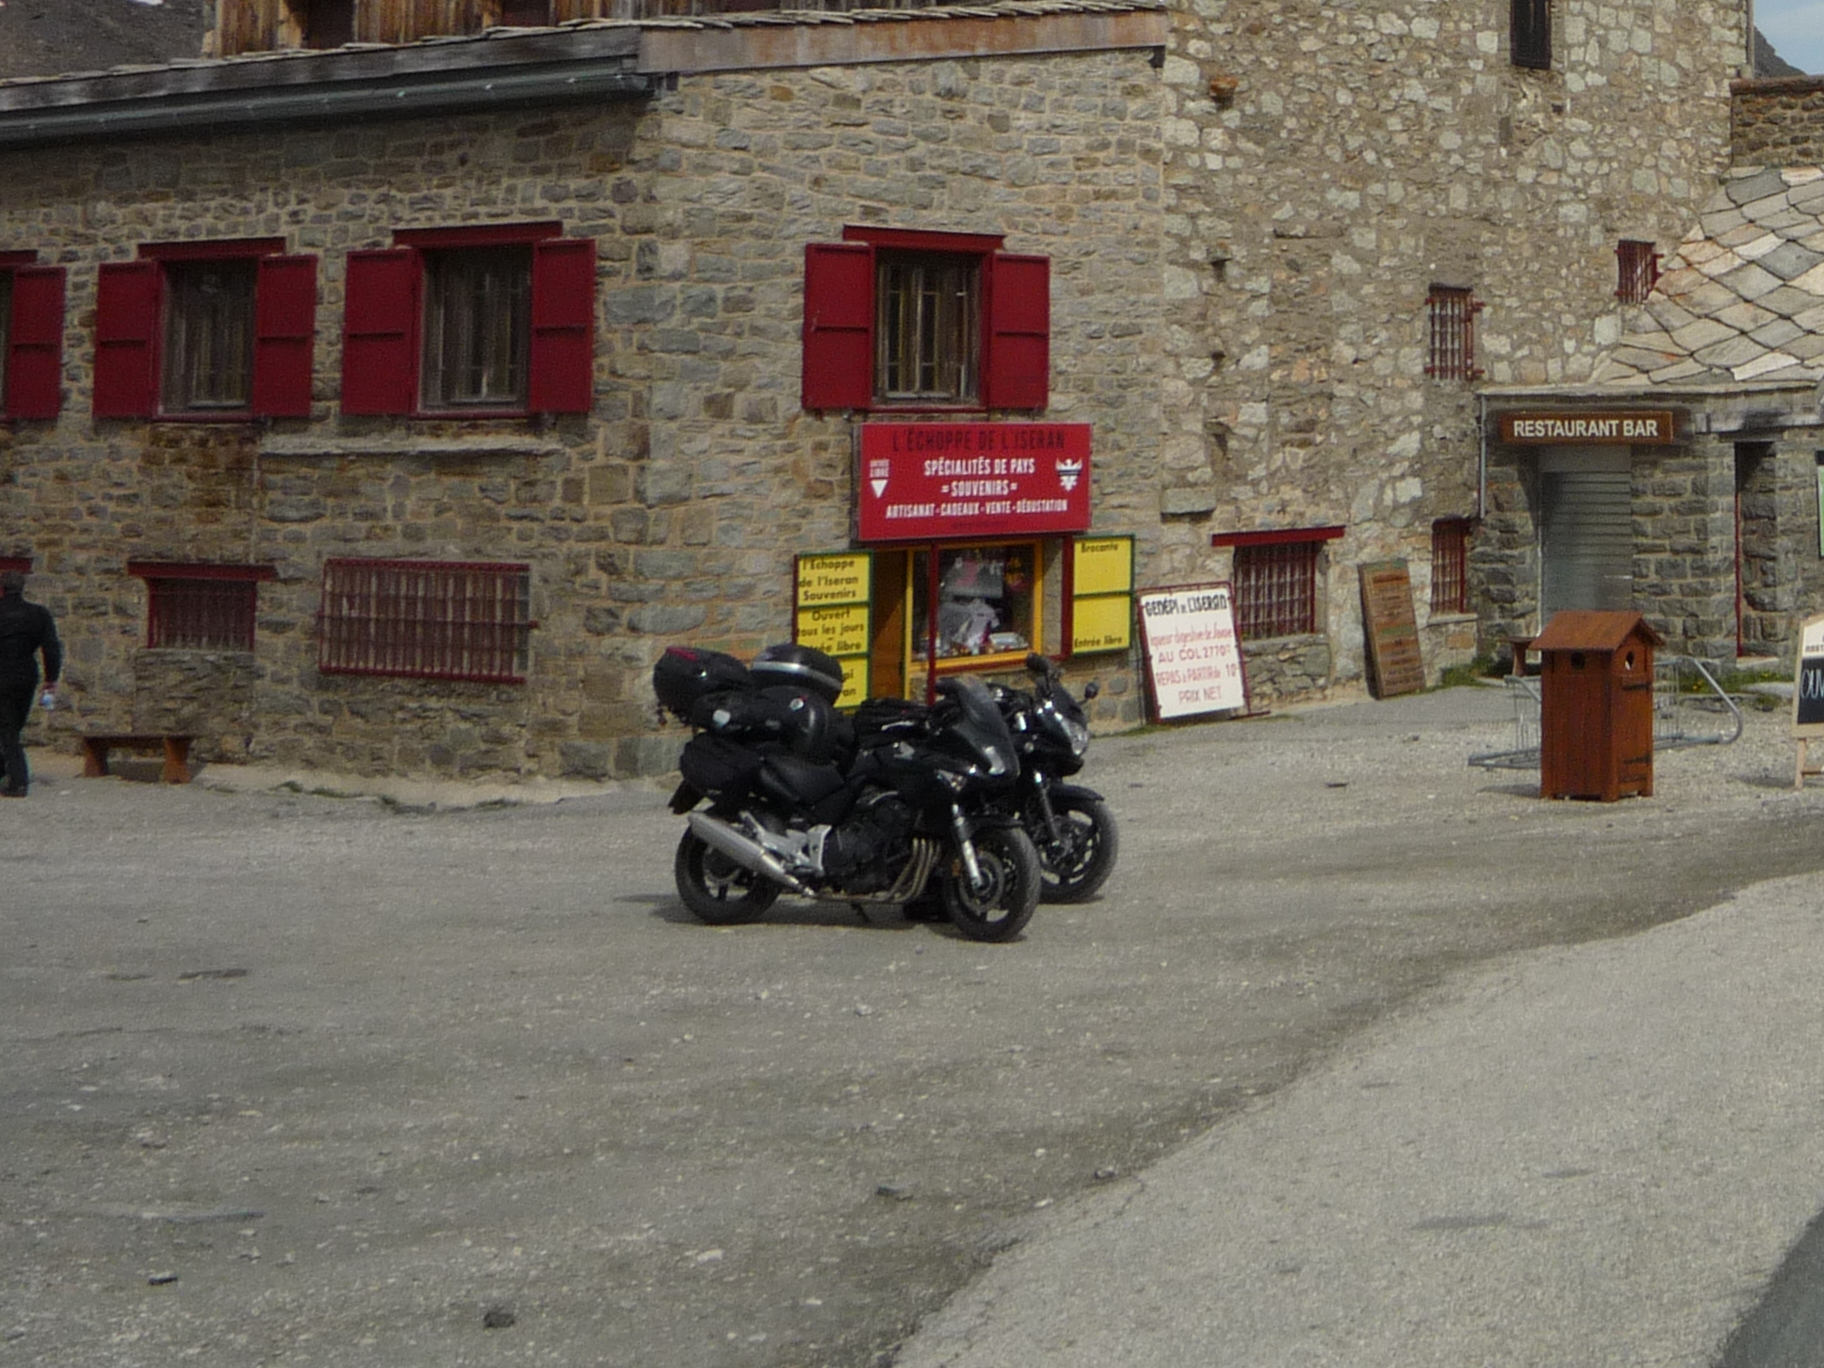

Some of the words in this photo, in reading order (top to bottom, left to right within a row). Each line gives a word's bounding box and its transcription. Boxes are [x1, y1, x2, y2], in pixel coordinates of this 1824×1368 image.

[1513, 420, 1619, 437] RESTAURANT
[1622, 420, 1659, 437] BAR
[979, 430, 994, 450] DE
[924, 456, 991, 476] SPÉCIALITÉS
[994, 459, 1007, 474] DE
[1010, 458, 1035, 474] PAYS
[951, 480, 1009, 497] SOUVENIRS
[886, 504, 935, 519] ARTISANAT
[941, 502, 980, 516] CADEAUX
[985, 500, 1011, 515] VENTE
[1016, 498, 1068, 513] DÉGUSTATION
[799, 578, 812, 587] de
[803, 588, 856, 601] Souvenirs
[812, 609, 850, 621] Ouvert
[822, 624, 836, 635] les
[840, 623, 864, 636] jours
[837, 642, 862, 651] libre
[1158, 650, 1174, 663] AU
[1179, 648, 1202, 661] COL
[1156, 670, 1181, 686] REPAS
[1179, 690, 1200, 703] PRIX
[1203, 686, 1222, 701] NET
